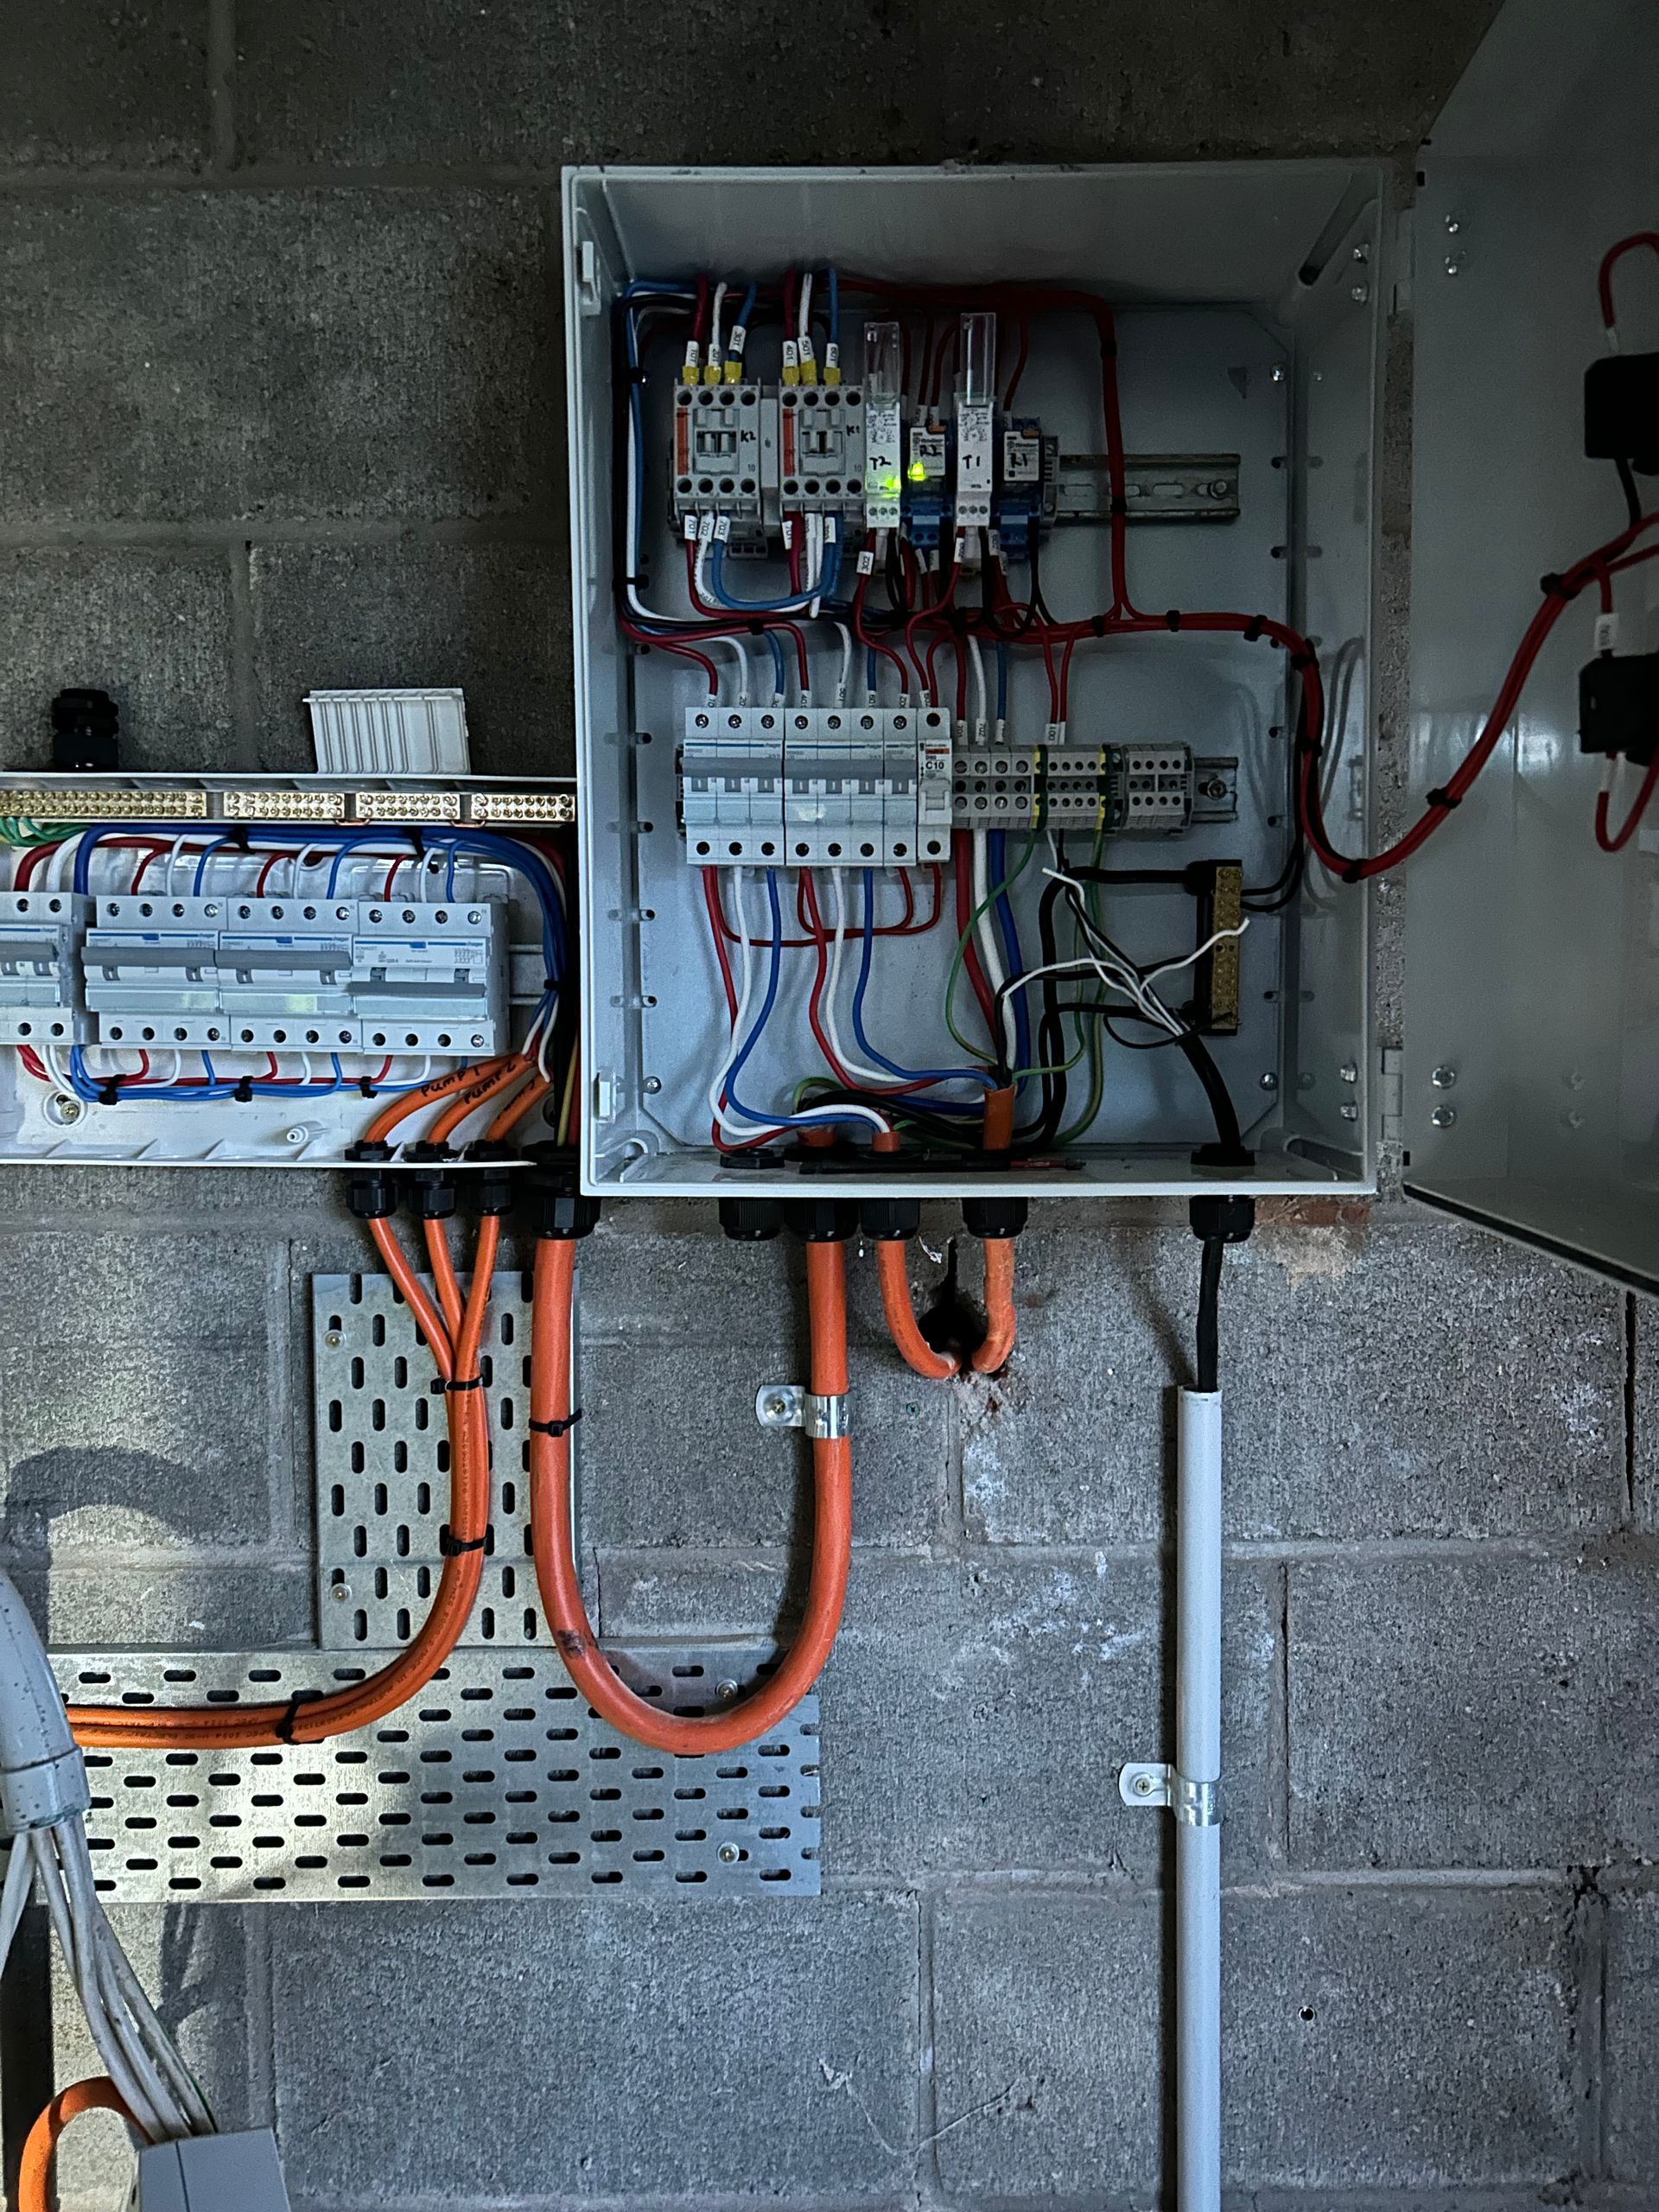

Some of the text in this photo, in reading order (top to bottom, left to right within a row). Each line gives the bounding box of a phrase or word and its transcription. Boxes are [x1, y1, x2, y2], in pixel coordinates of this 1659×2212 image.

[741, 429, 756, 442] K2
[869, 455, 892, 470] T2
[962, 454, 981, 470] T1
[701, 521, 710, 537] 702
[718, 520, 728, 536] 703
[861, 556, 871, 571] 302
[925, 761, 944, 770] C10
